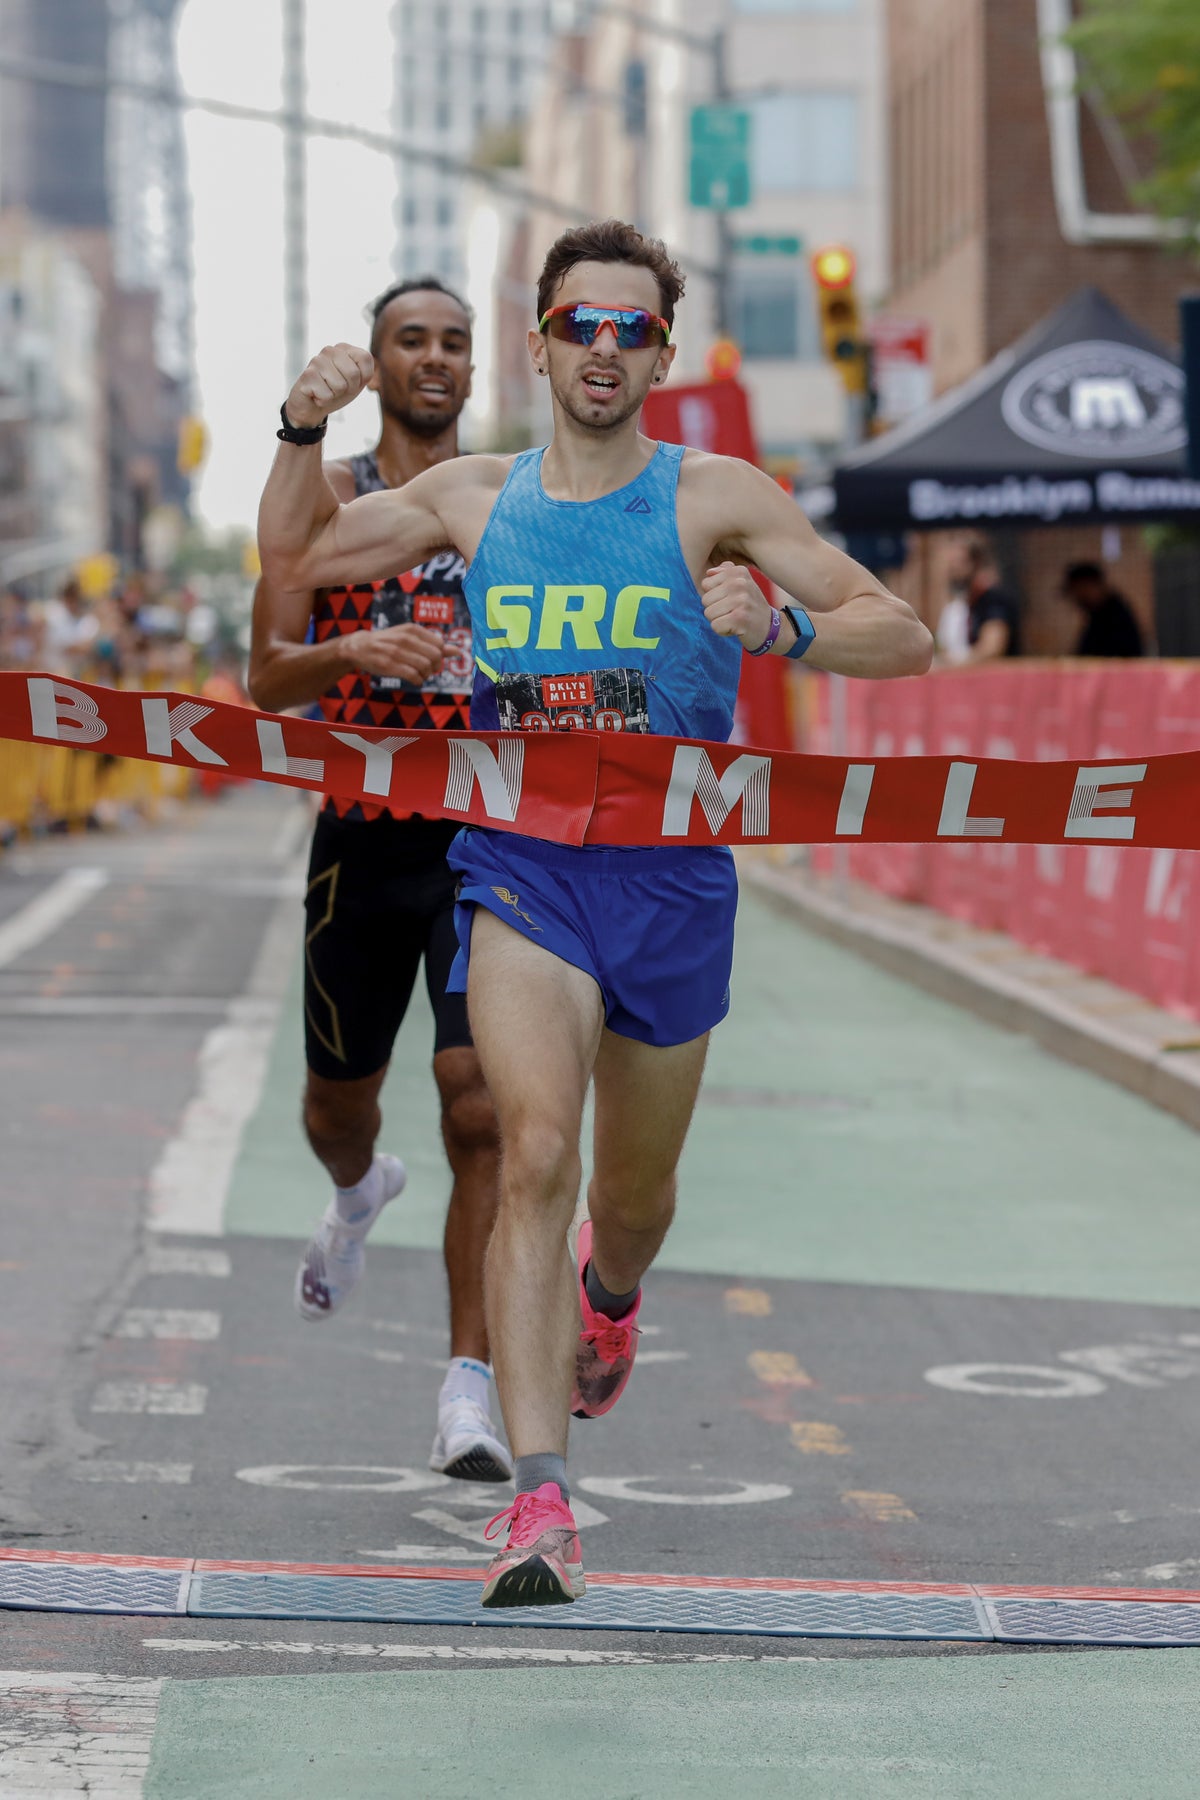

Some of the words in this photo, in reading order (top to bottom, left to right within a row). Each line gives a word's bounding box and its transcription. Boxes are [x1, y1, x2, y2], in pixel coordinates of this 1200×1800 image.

[910, 477, 1091, 519] Brooklyn
[485, 585, 671, 650] SRC
[549, 682, 586, 691] BKLYN
[550, 691, 587, 701] MILE
[27, 678, 524, 821] BKLYN
[662, 745, 1147, 839] MILE
